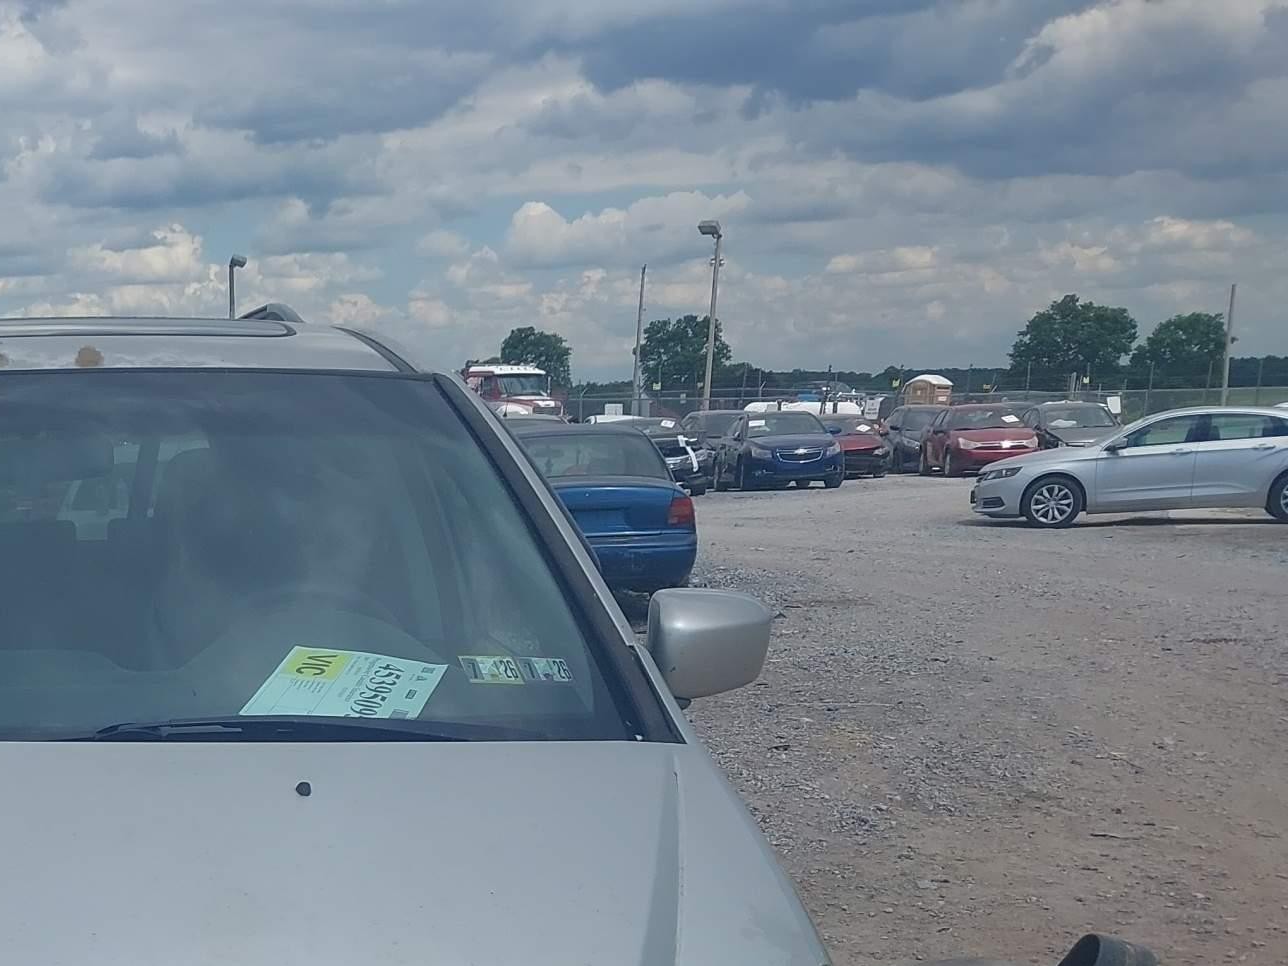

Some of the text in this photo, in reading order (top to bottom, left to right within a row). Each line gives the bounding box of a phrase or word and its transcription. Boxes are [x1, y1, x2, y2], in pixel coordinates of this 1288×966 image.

[295, 654, 338, 676] VIC
[499, 660, 518, 679] 26
[552, 660, 572, 679] 26
[344, 663, 405, 718] 4539509
